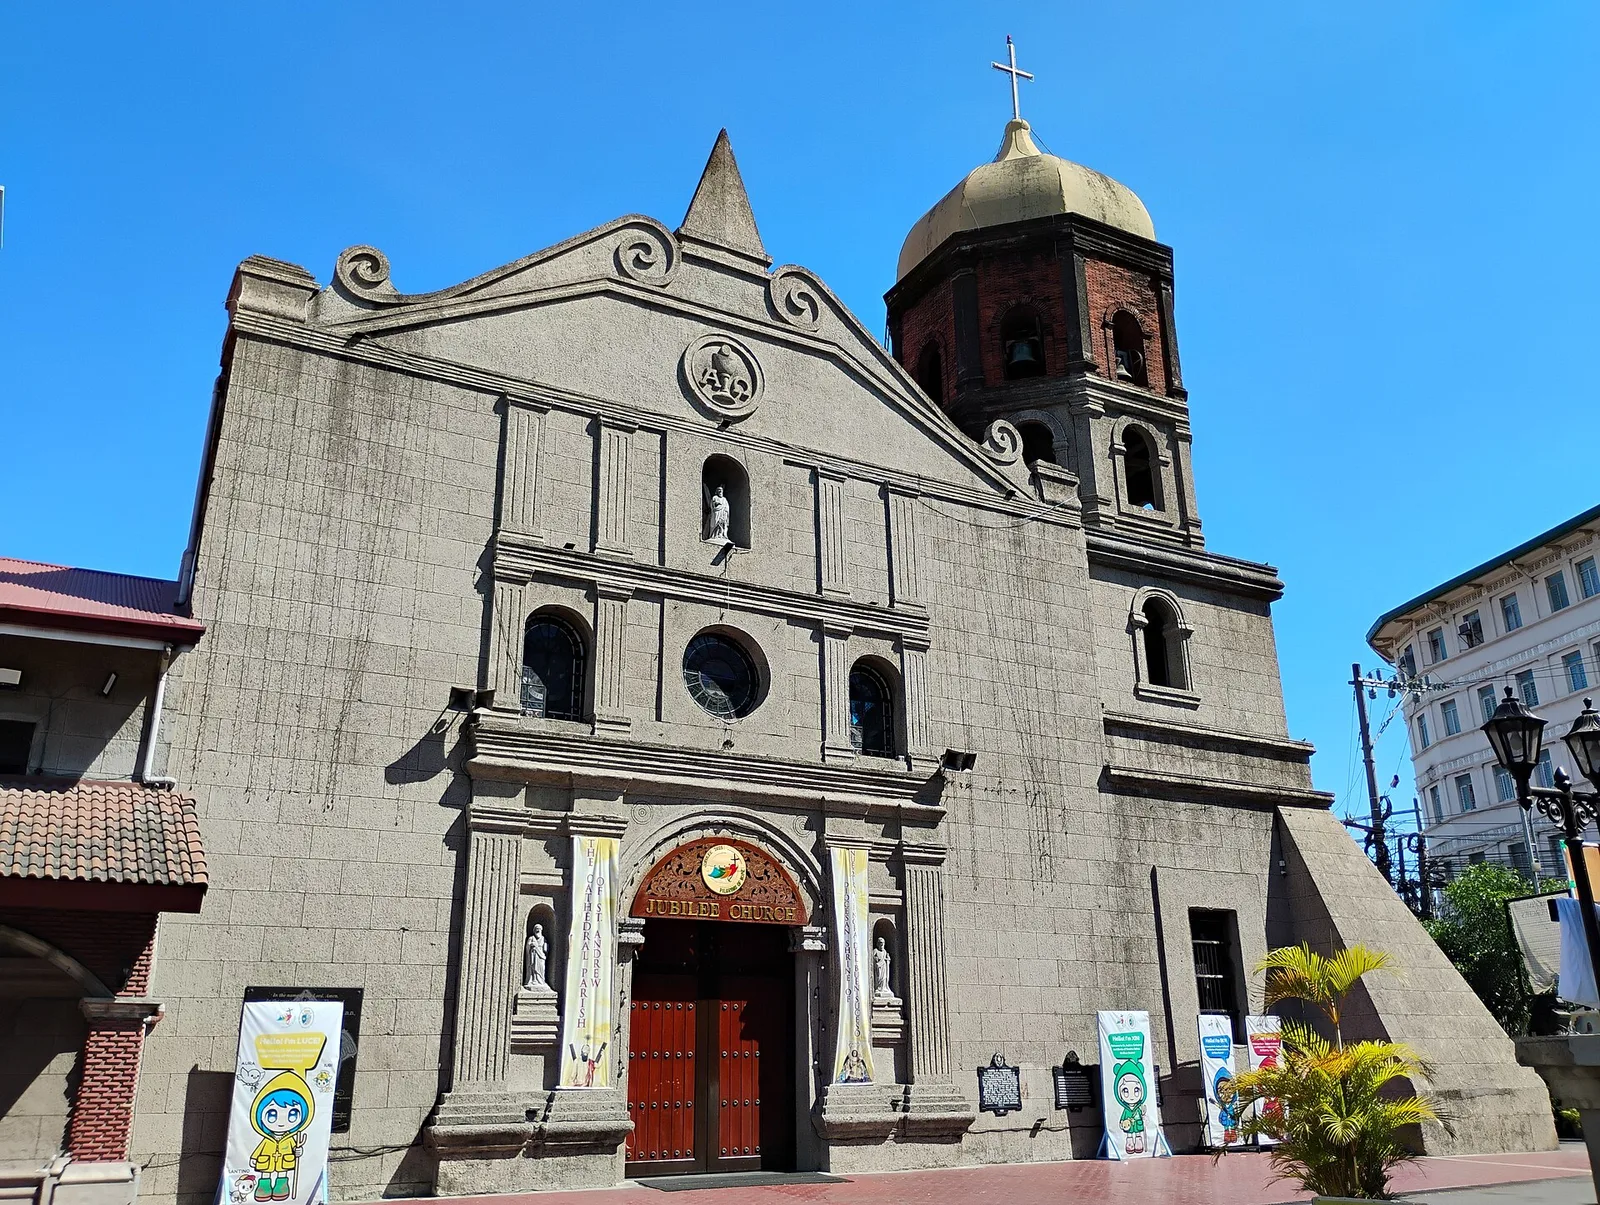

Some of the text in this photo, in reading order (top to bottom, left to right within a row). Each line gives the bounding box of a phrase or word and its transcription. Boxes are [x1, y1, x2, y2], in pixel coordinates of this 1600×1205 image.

[577, 839, 595, 1028] THE CATHEDRAL PARISH
[591, 877, 604, 988] OF ST. ANDREW
[646, 899, 797, 921] JUBILEE CHURCH
[845, 988, 851, 1003] OF
